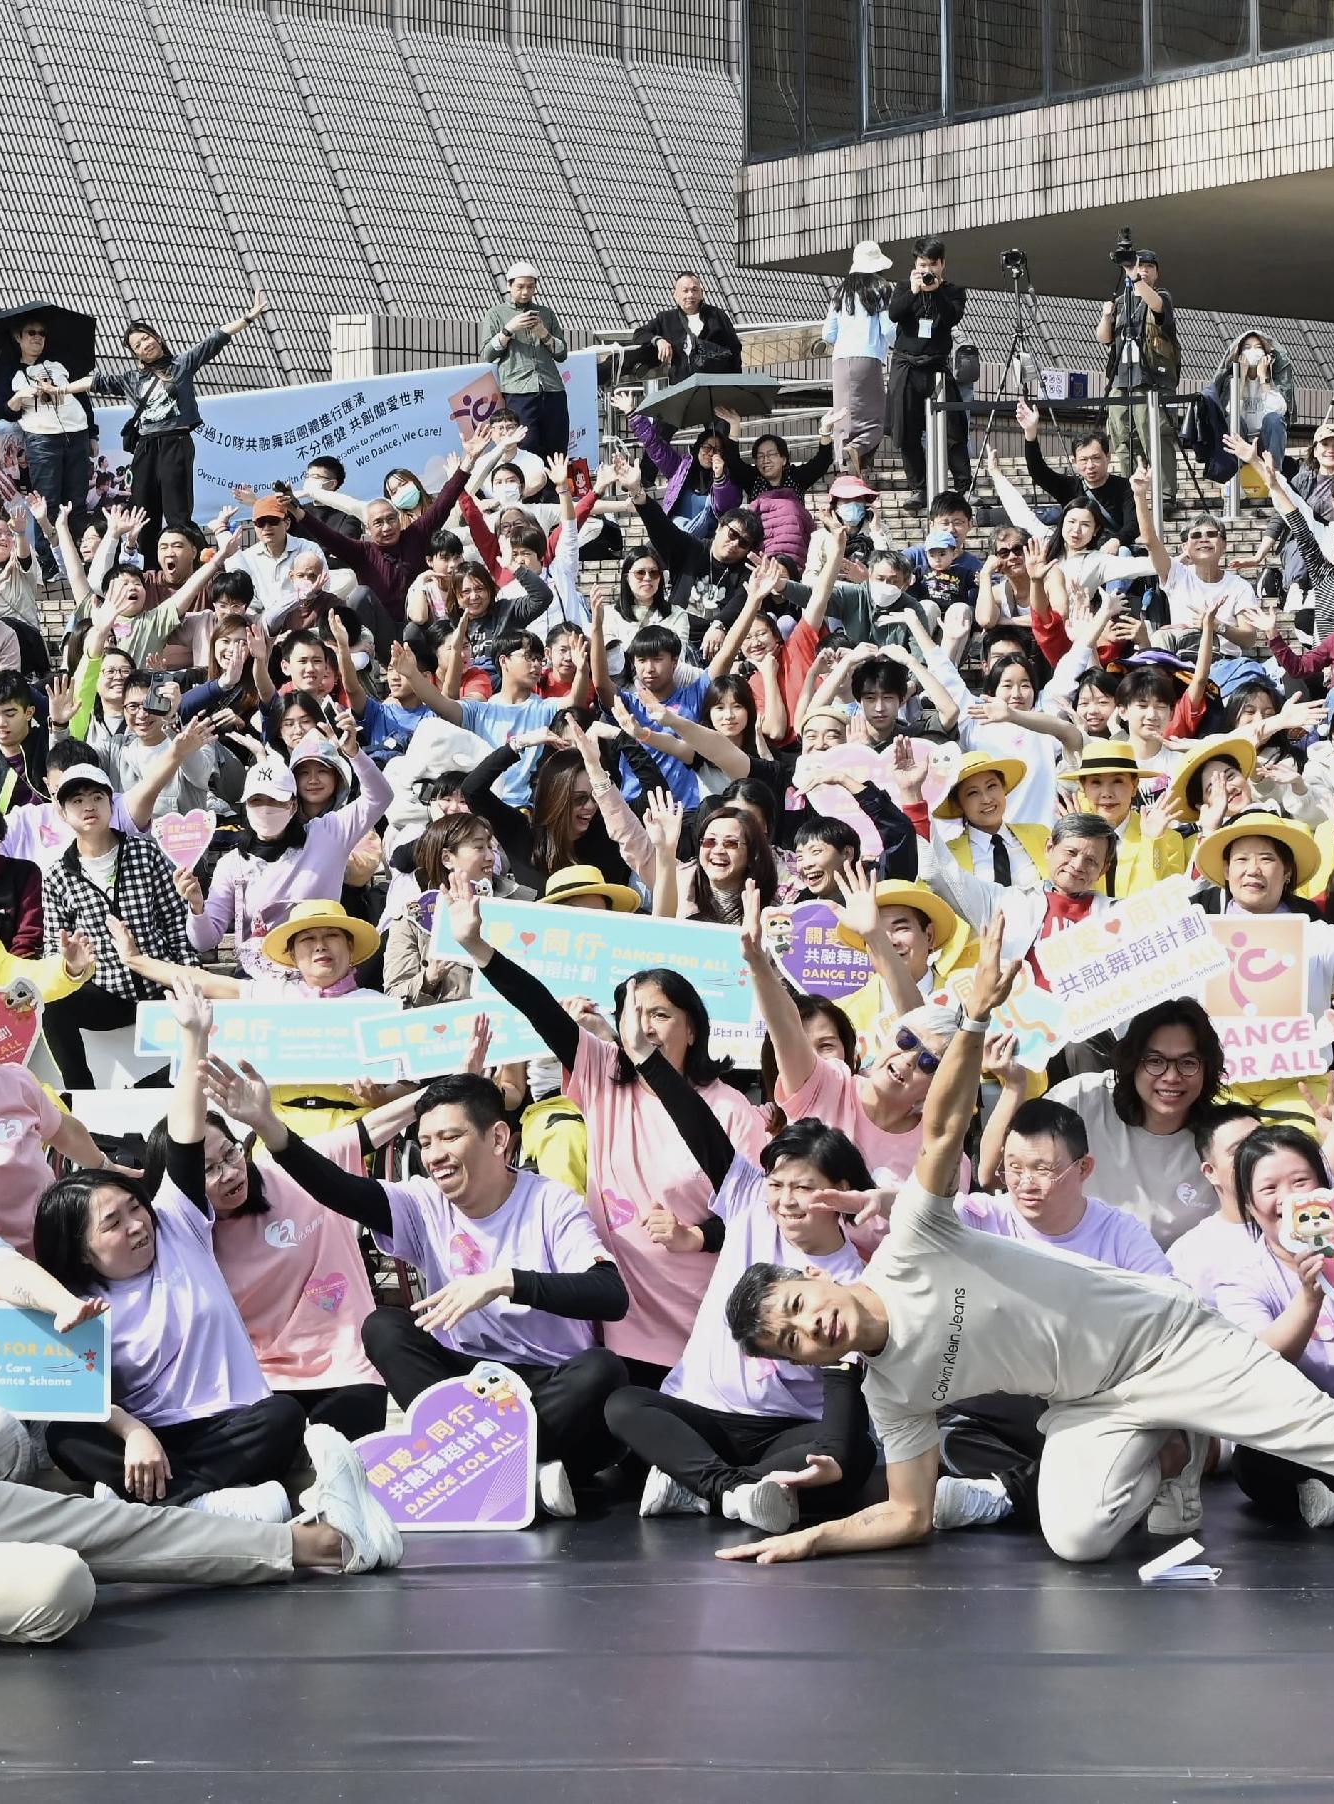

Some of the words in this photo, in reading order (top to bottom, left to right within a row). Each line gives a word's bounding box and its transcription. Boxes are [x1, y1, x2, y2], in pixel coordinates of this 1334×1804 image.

[296, 426, 348, 460] 不分傷健
[356, 454, 371, 468] We
[371, 439, 402, 459] Dance,
[402, 431, 417, 442] We
[417, 426, 442, 438] Care!
[197, 468, 216, 484] Over
[361, 436, 369, 445] to
[519, 958, 598, 984] 舞蹈計劃
[611, 944, 666, 964] DANCE
[702, 957, 731, 973] ALL
[804, 947, 869, 967] 共融舞蹈
[1058, 911, 1208, 1001] 共融舞蹈計劃
[802, 968, 846, 980] DANCE
[1222, 1020, 1310, 1049] ANCE
[1270, 1050, 1323, 1074] ALL
[948, 1288, 966, 1332] Jeans
[3, 1341, 38, 1358] FOR
[43, 1342, 74, 1358] ALL
[943, 1333, 962, 1365] Klein
[5, 1362, 32, 1374] Care
[28, 1375, 73, 1388] Scheme
[931, 1363, 954, 1401] Calvin
[425, 1403, 476, 1444] 同行
[388, 1416, 501, 1503] 共融舞蹈計劃
[405, 1474, 458, 1515] DANCE
[455, 1451, 490, 1476] FOR
[490, 1431, 518, 1453] ALL
